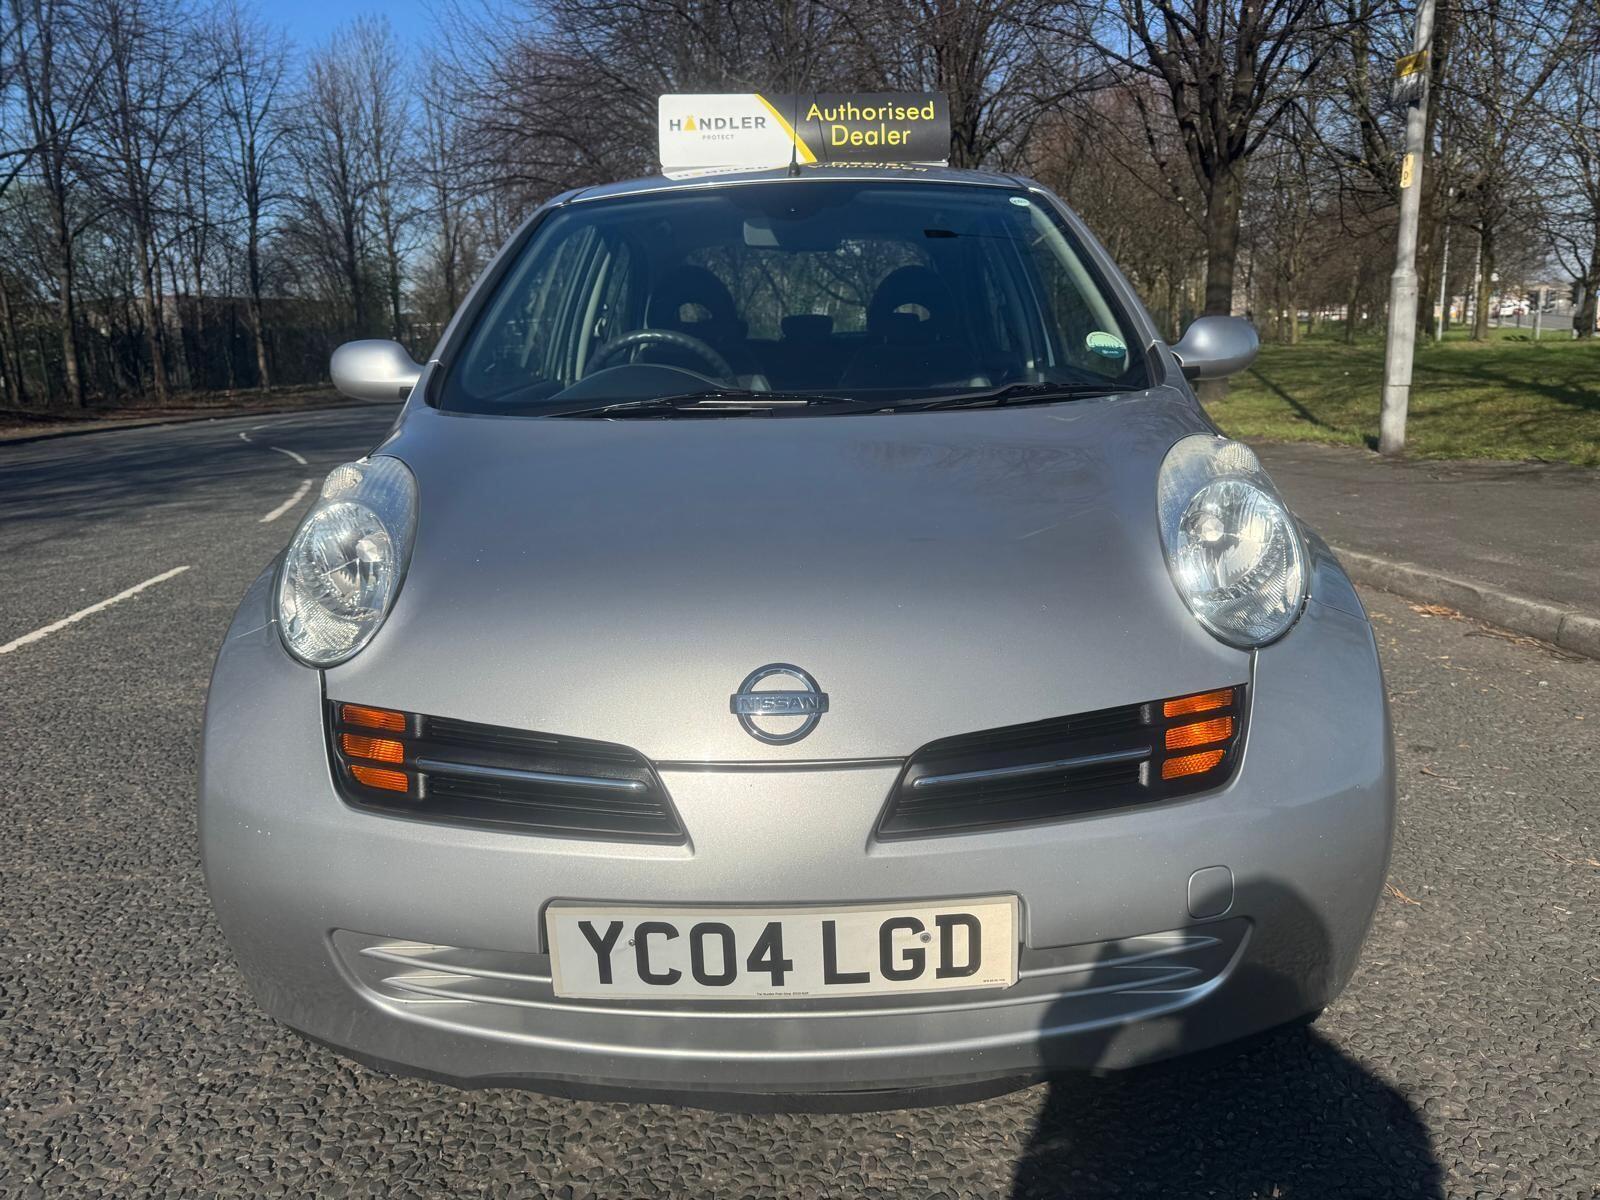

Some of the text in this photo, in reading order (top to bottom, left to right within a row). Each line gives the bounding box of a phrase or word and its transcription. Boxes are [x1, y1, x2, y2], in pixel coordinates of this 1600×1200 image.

[806, 102, 934, 121] Authorised
[669, 115, 766, 131] HANDLER
[831, 124, 911, 146] Dealer
[738, 696, 820, 711] NISSAN
[578, 913, 982, 986] YC04 LGD
